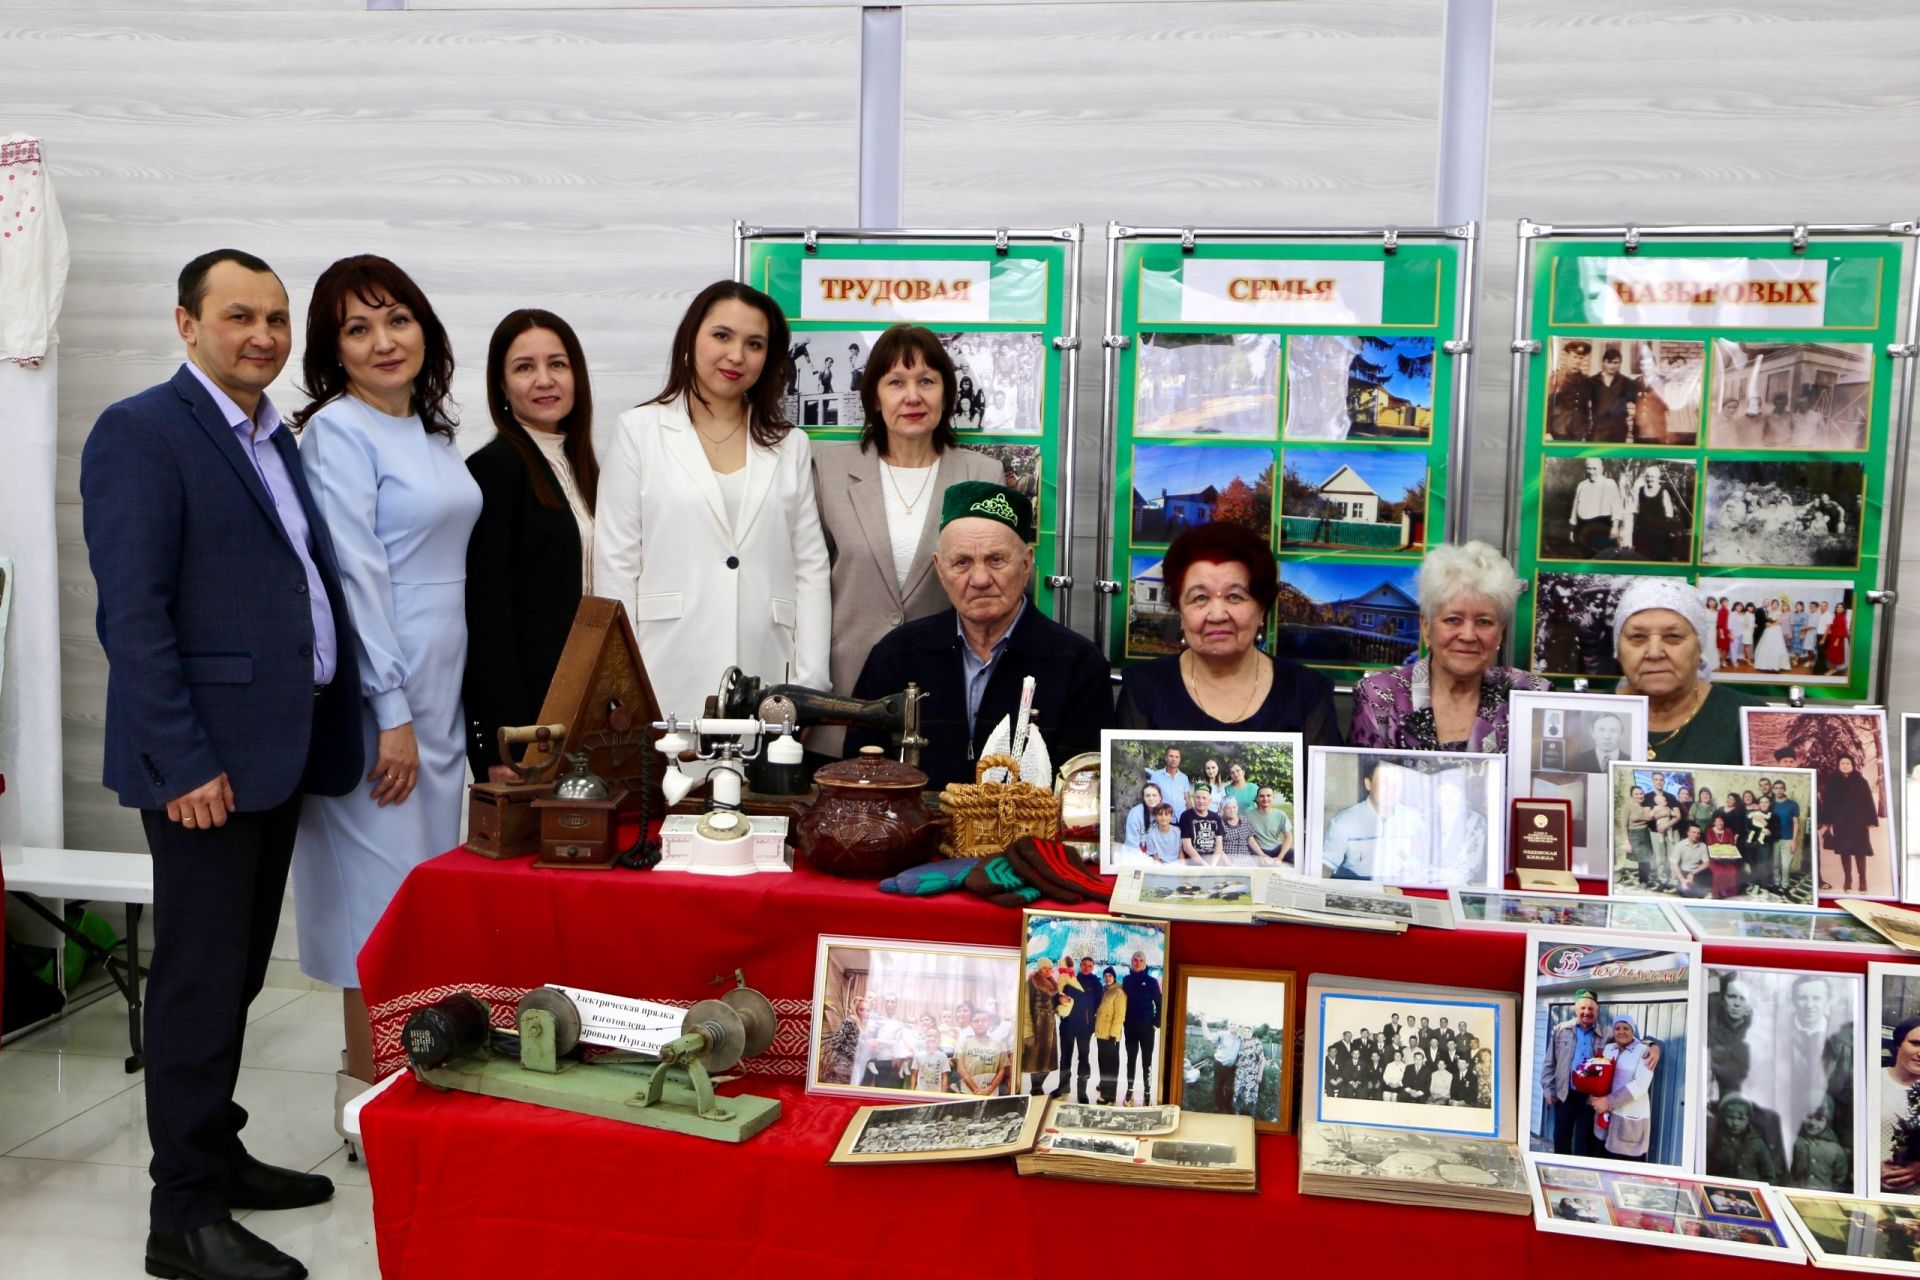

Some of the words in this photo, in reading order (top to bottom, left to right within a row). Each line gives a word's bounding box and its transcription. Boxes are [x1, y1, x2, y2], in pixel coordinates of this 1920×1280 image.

[820, 278, 972, 305] ТРУДОВАЯ
[1228, 277, 1336, 302] СЕМЬЯ
[1554, 951, 1585, 973] 55
[575, 992, 640, 1014] Электрическая
[641, 1007, 675, 1020] прялка
[592, 1014, 646, 1031] изготовлена
[619, 1033, 661, 1050] Нургалее
